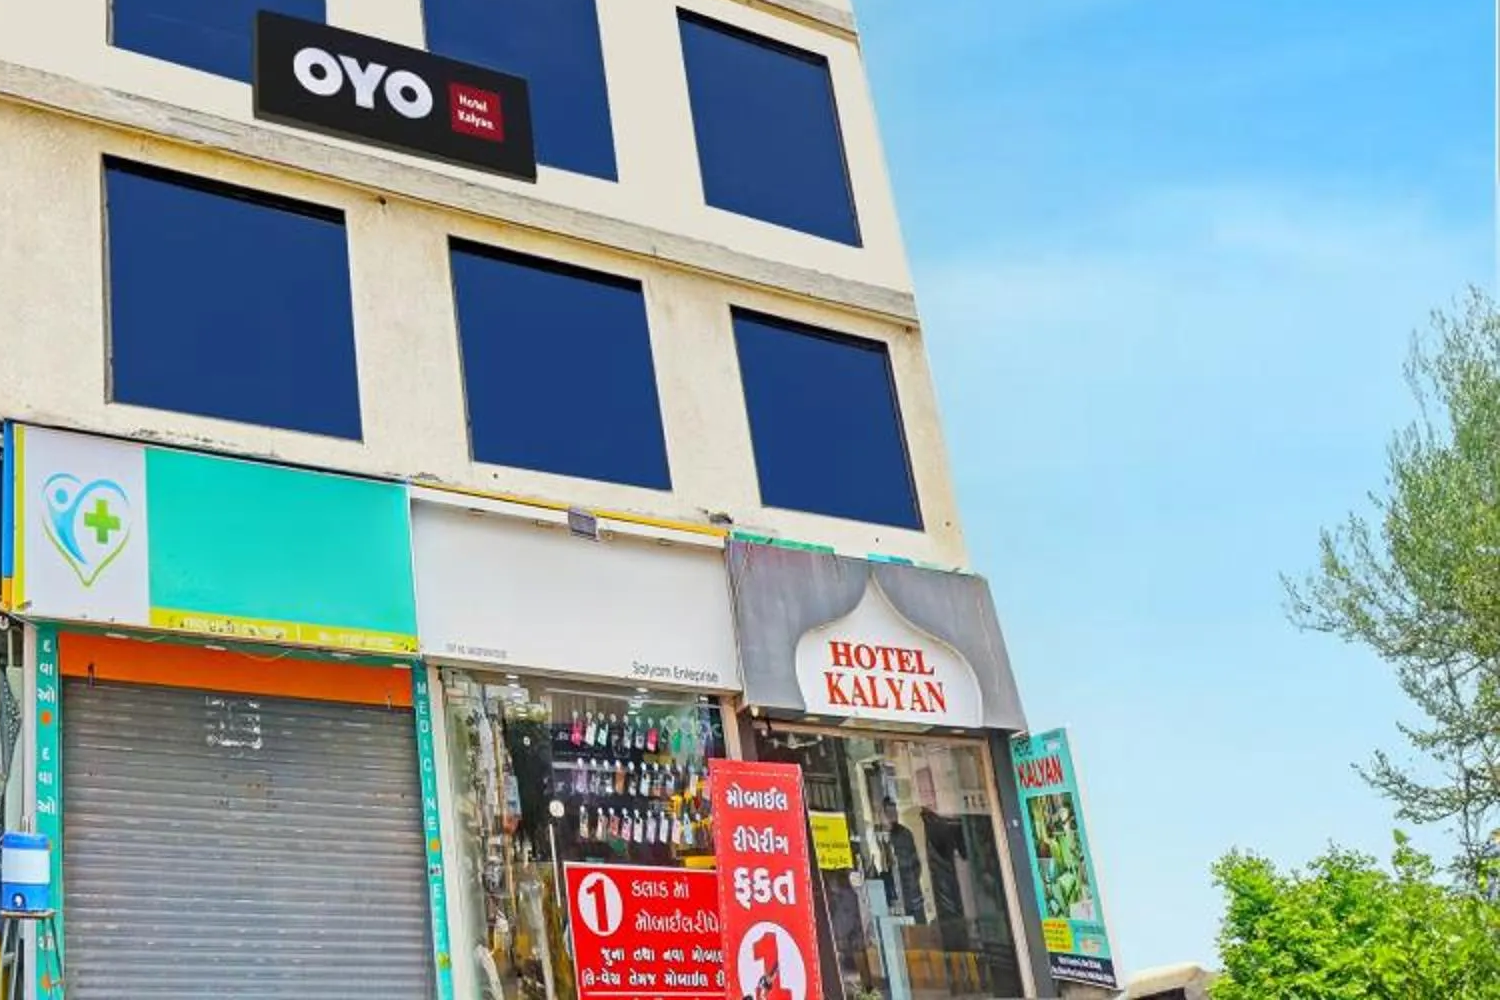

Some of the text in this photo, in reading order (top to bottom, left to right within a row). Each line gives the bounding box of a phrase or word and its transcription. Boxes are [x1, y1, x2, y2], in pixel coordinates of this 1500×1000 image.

[293, 47, 433, 119] OYO
[458, 110, 495, 130] Kalyan
[459, 94, 488, 113] Hotel
[828, 640, 935, 676] HOTEL
[823, 671, 947, 713] KALYAN
[1018, 754, 1064, 789] KALYAN
[586, 878, 609, 932] 1
